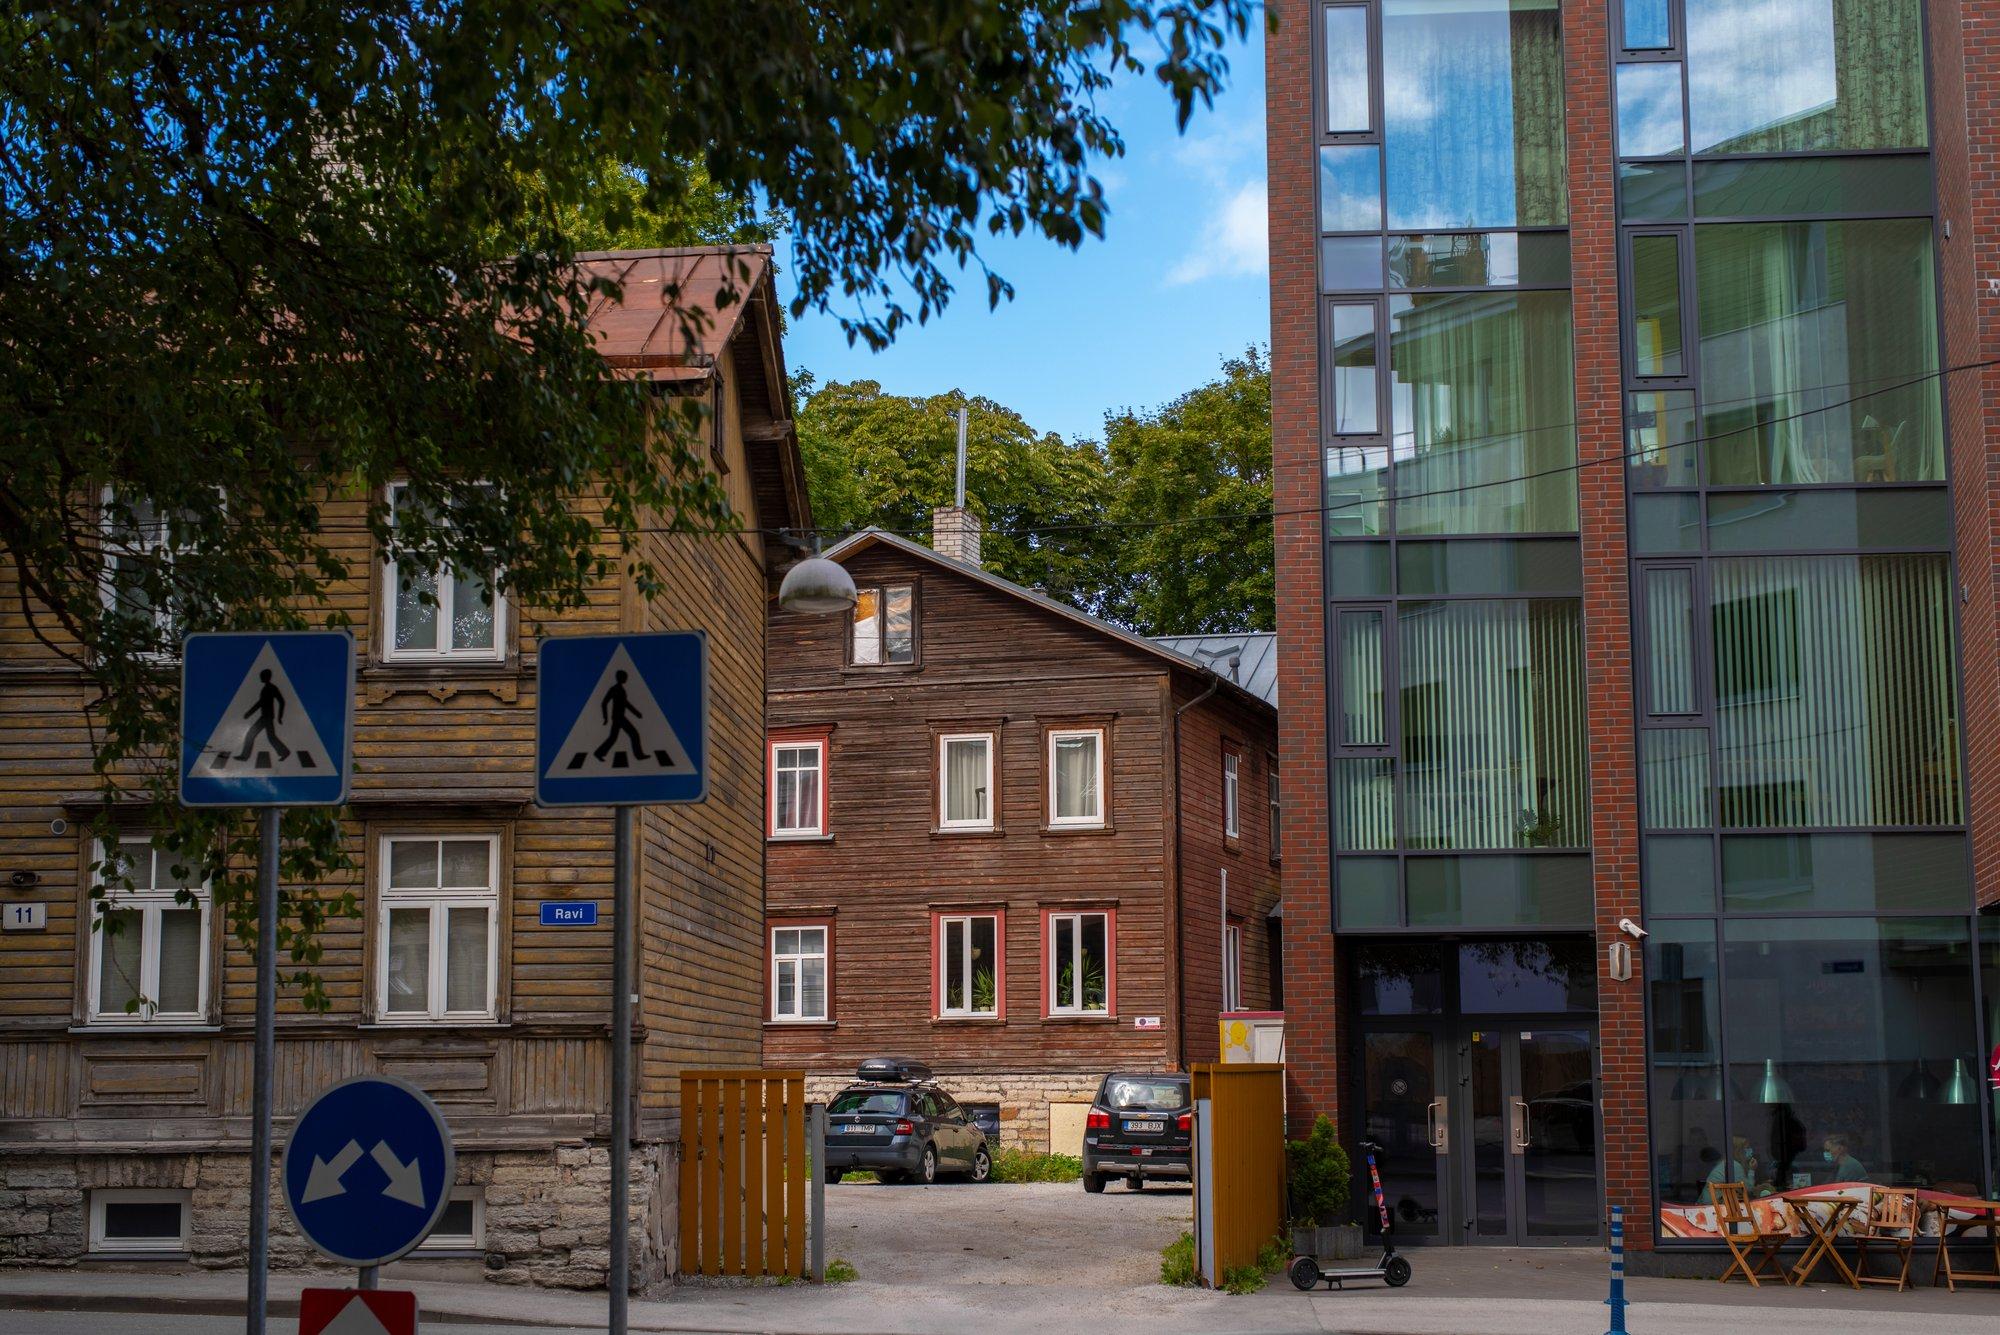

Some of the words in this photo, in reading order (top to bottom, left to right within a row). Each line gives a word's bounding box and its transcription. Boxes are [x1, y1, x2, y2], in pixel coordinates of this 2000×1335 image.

[15, 907, 32, 923] 11
[555, 908, 583, 919] Ravi
[1130, 1121, 1143, 1129] 393
